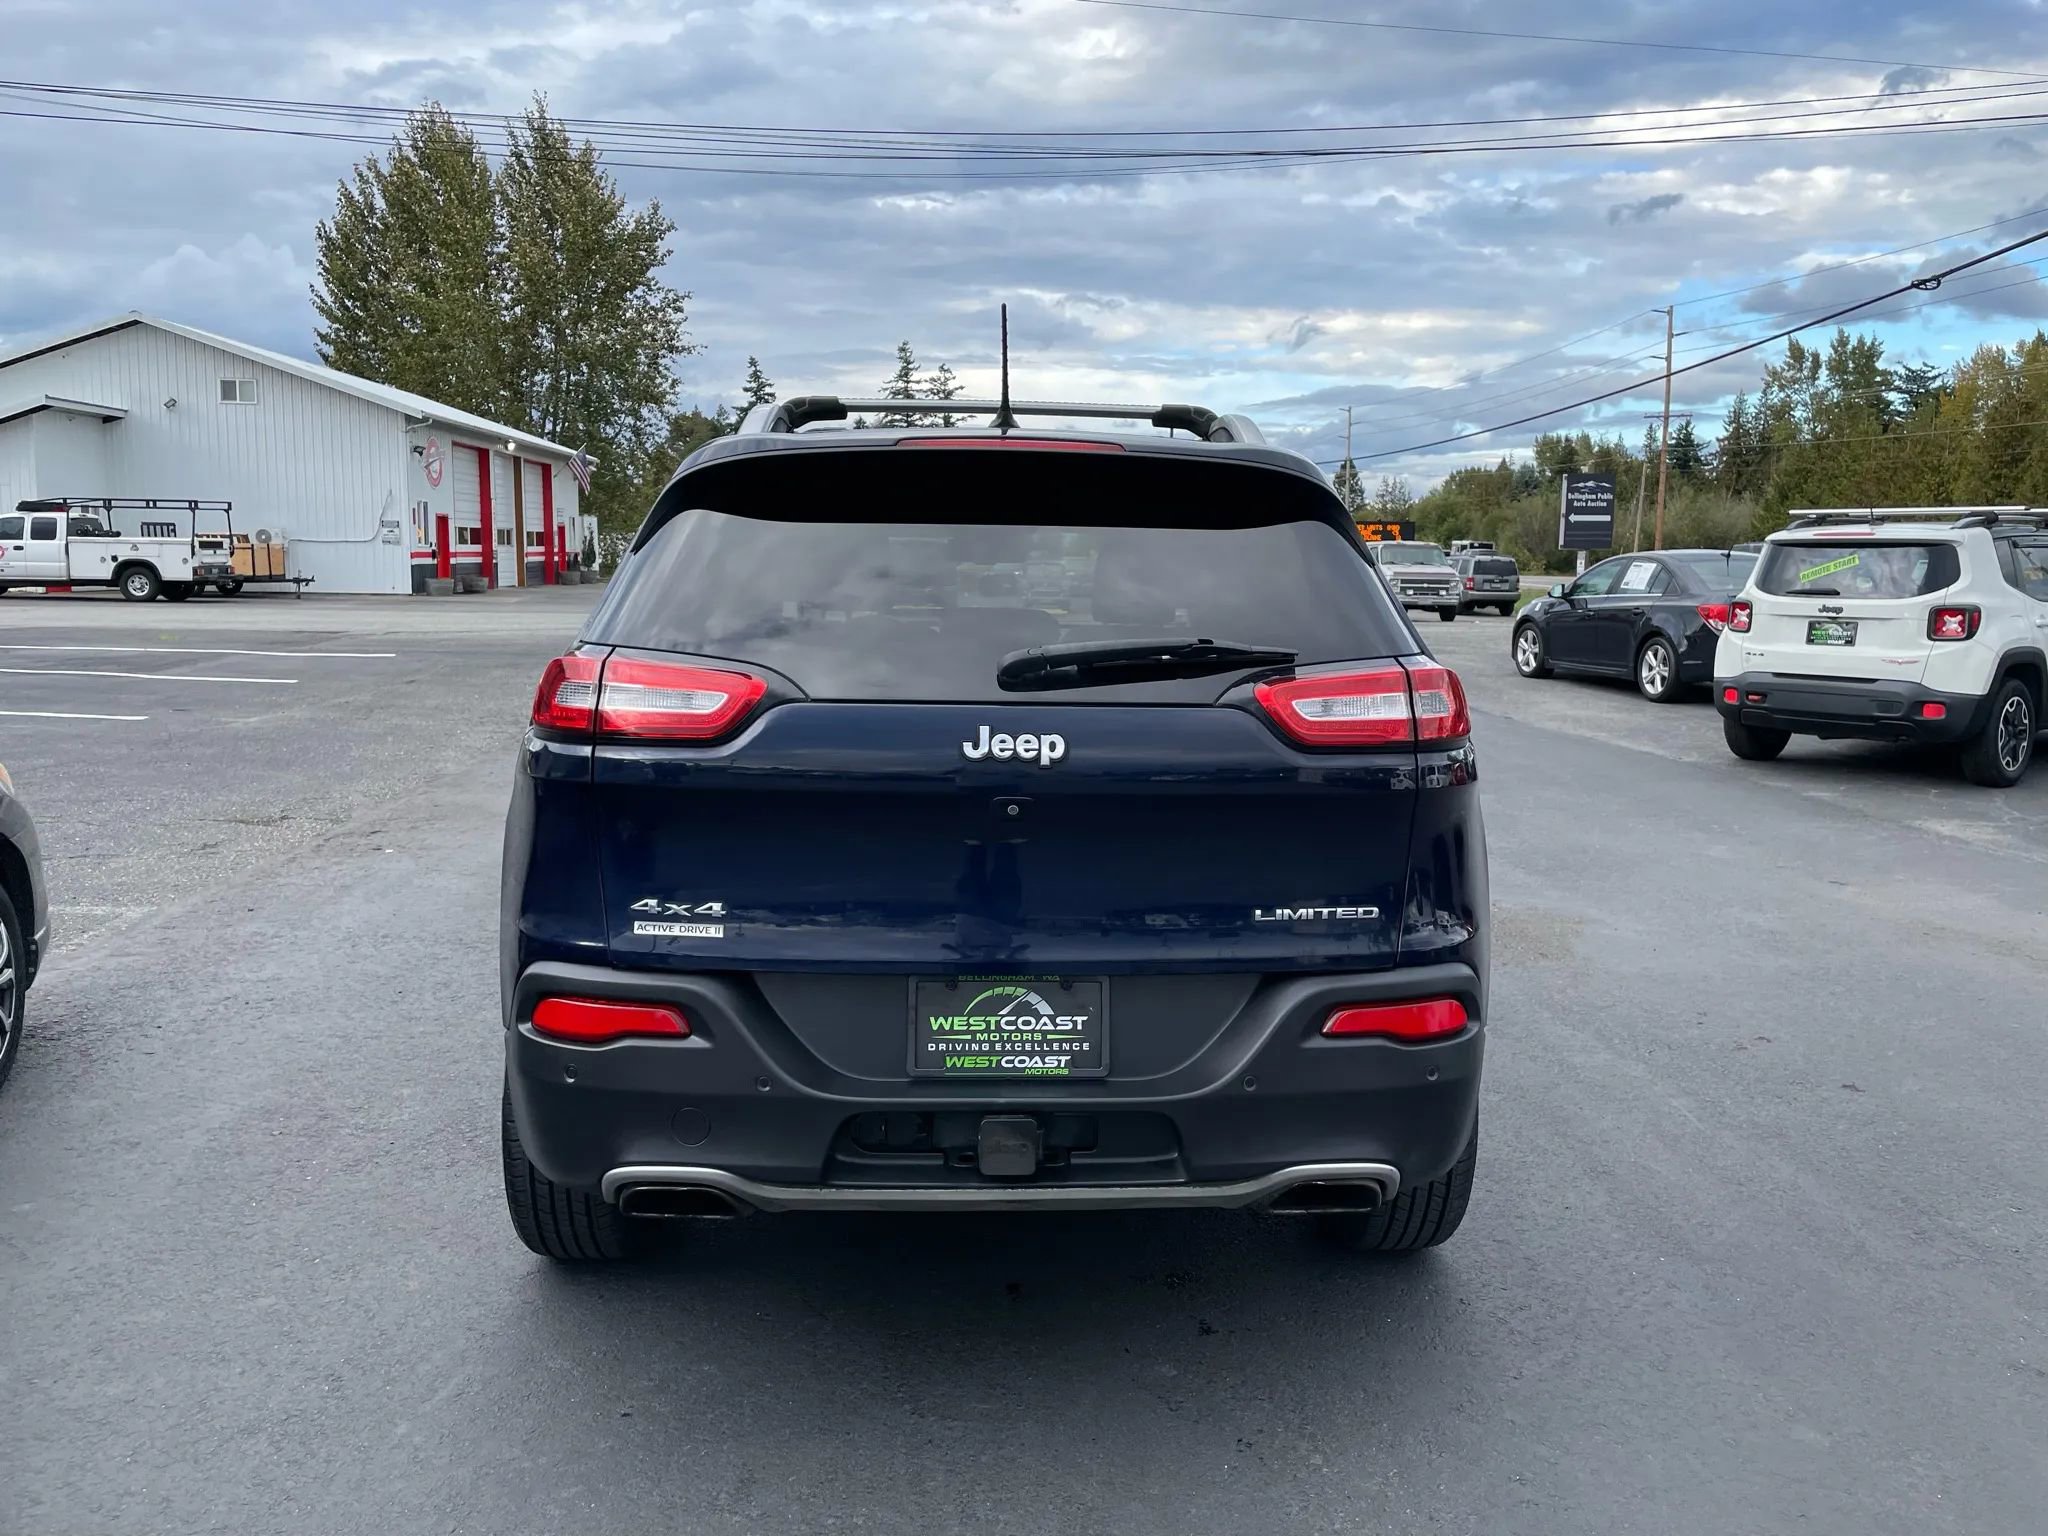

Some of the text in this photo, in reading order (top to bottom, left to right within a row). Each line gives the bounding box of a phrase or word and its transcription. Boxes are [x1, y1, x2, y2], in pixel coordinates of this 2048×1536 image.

[1801, 556, 1857, 581] REMOTE START
[1818, 604, 1844, 615] Jeep
[962, 725, 1066, 767] Jeep
[630, 899, 727, 917] 4x4
[1254, 906, 1380, 921] LIMITED
[636, 923, 676, 933] ACTIVE
[679, 925, 712, 934] DRIVE
[929, 1016, 1088, 1031] WESTCOAST
[976, 1032, 1042, 1041] MOTORS
[927, 1043, 990, 1051] DRIVING
[945, 1056, 1071, 1068] WESTCOAST
